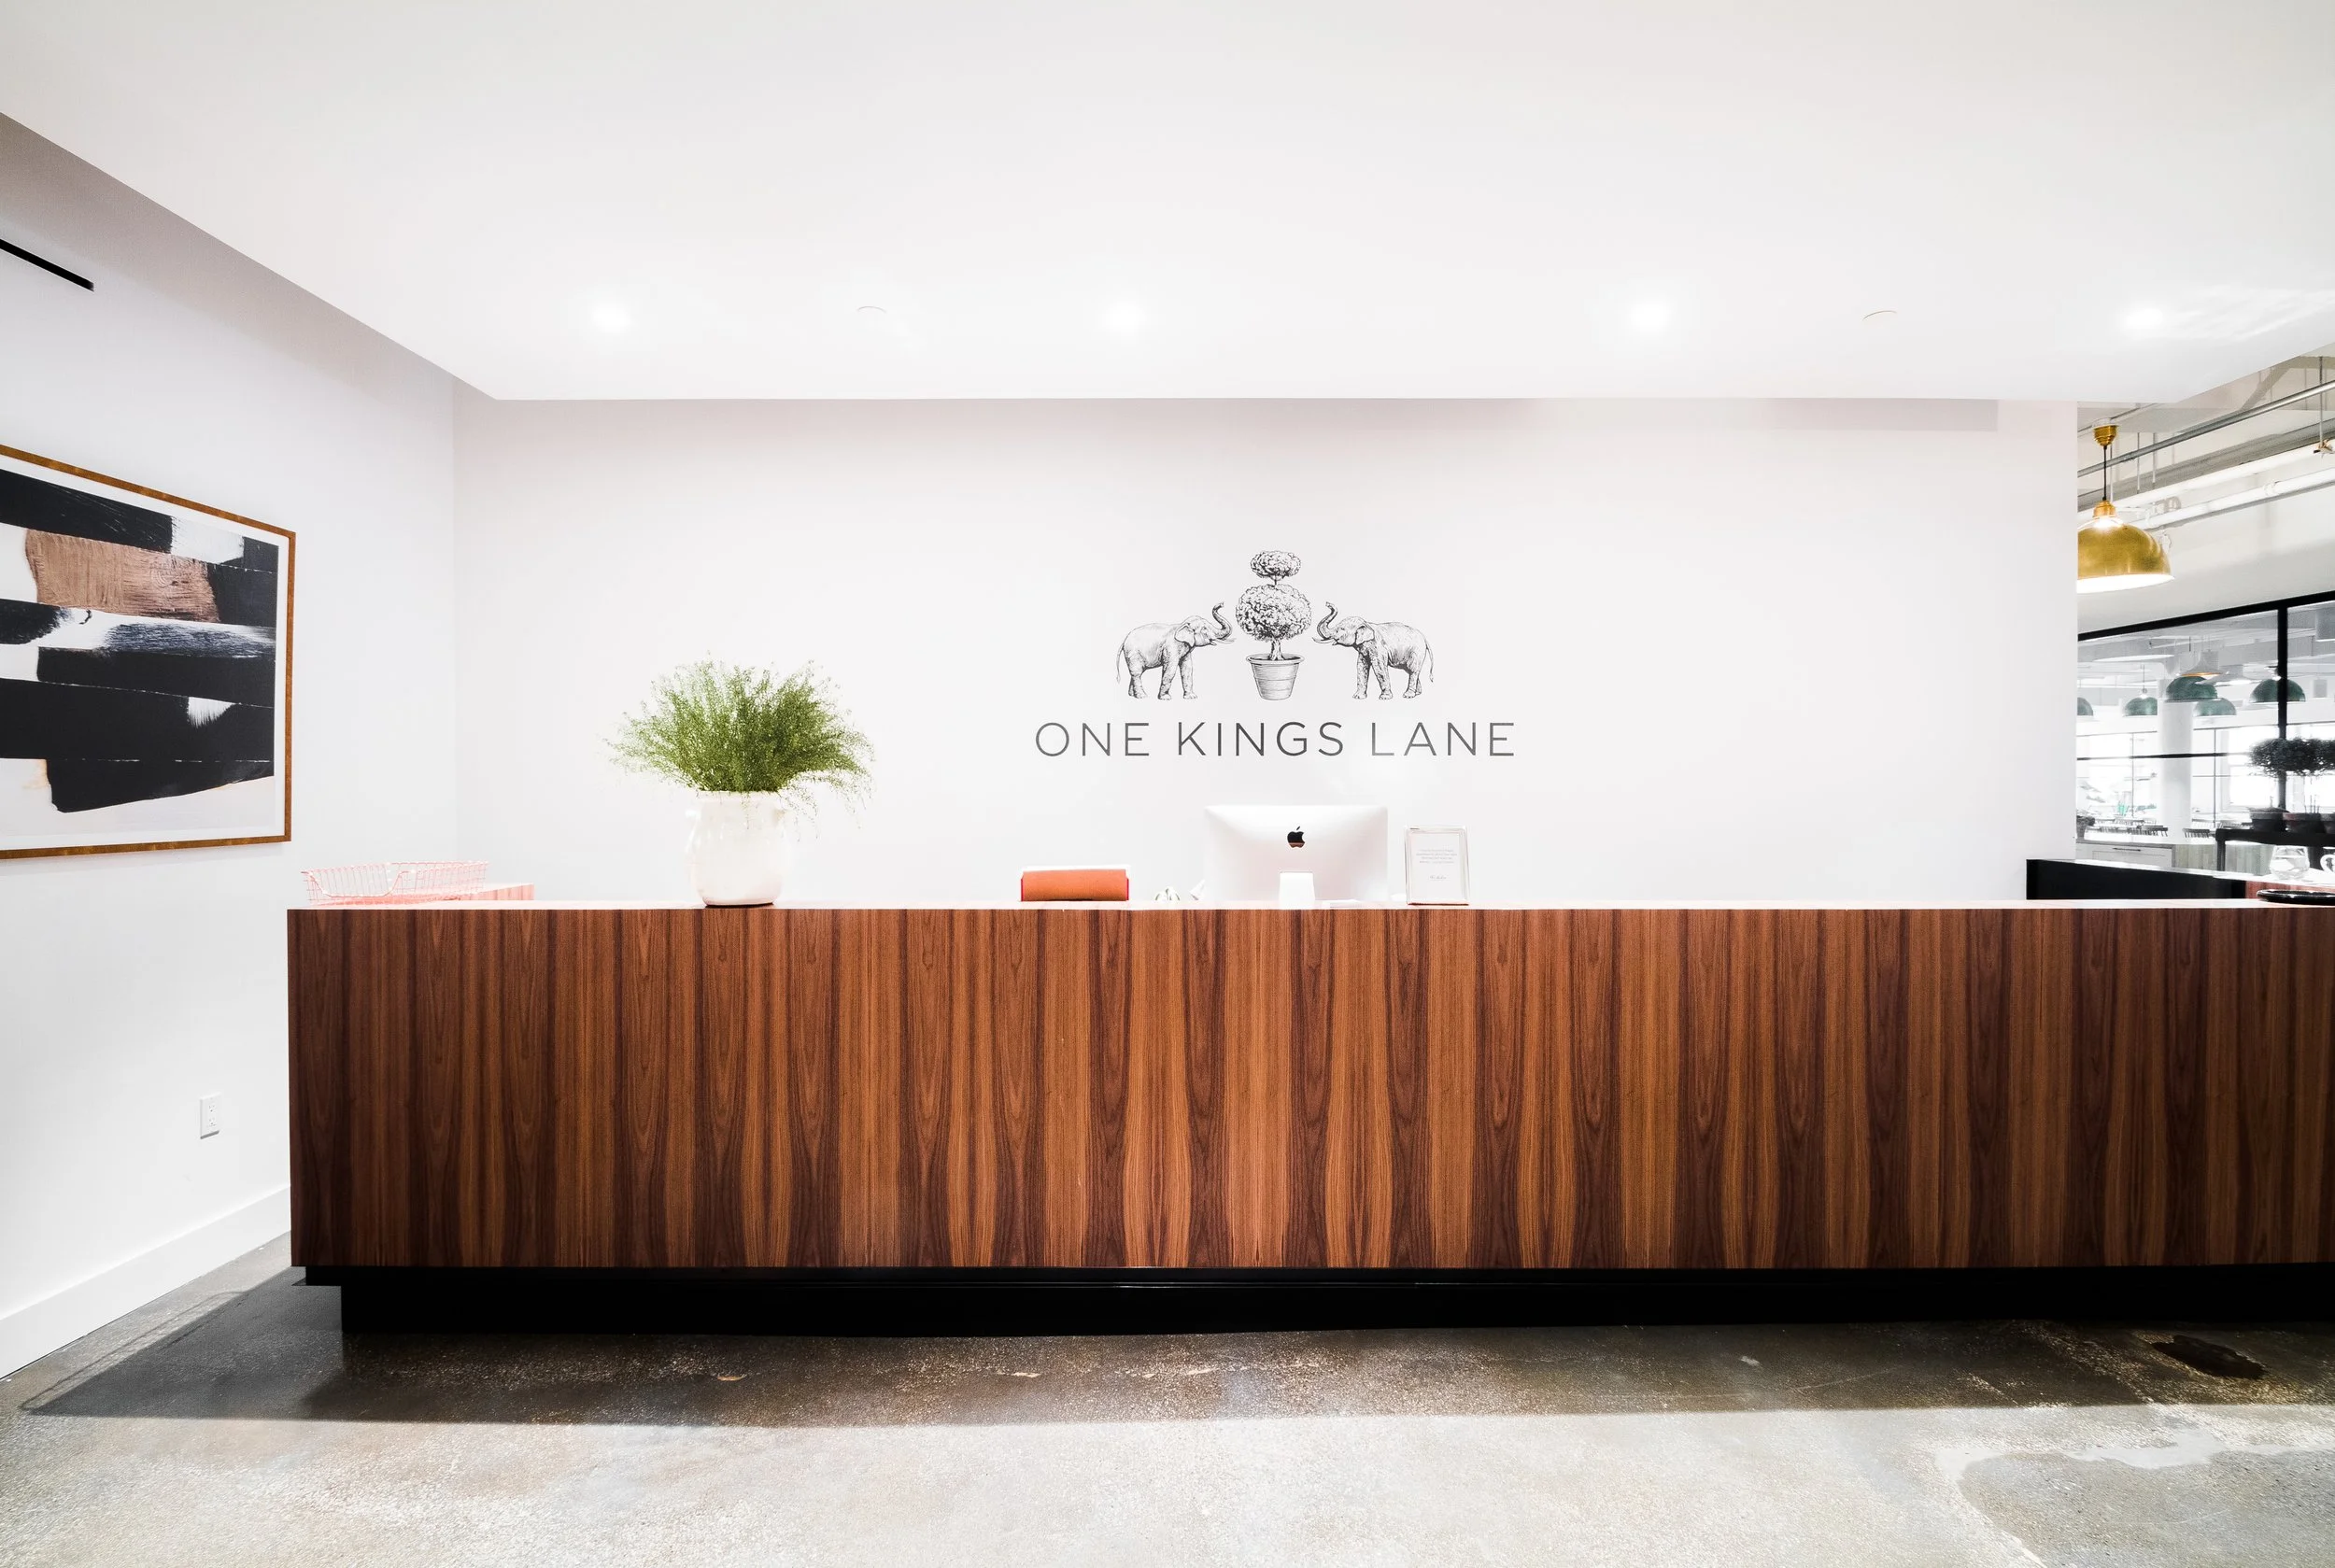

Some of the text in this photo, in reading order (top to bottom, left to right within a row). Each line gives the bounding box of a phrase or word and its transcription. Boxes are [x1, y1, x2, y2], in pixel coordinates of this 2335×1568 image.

[1035, 721, 1514, 757] ONE KINGS LANE
